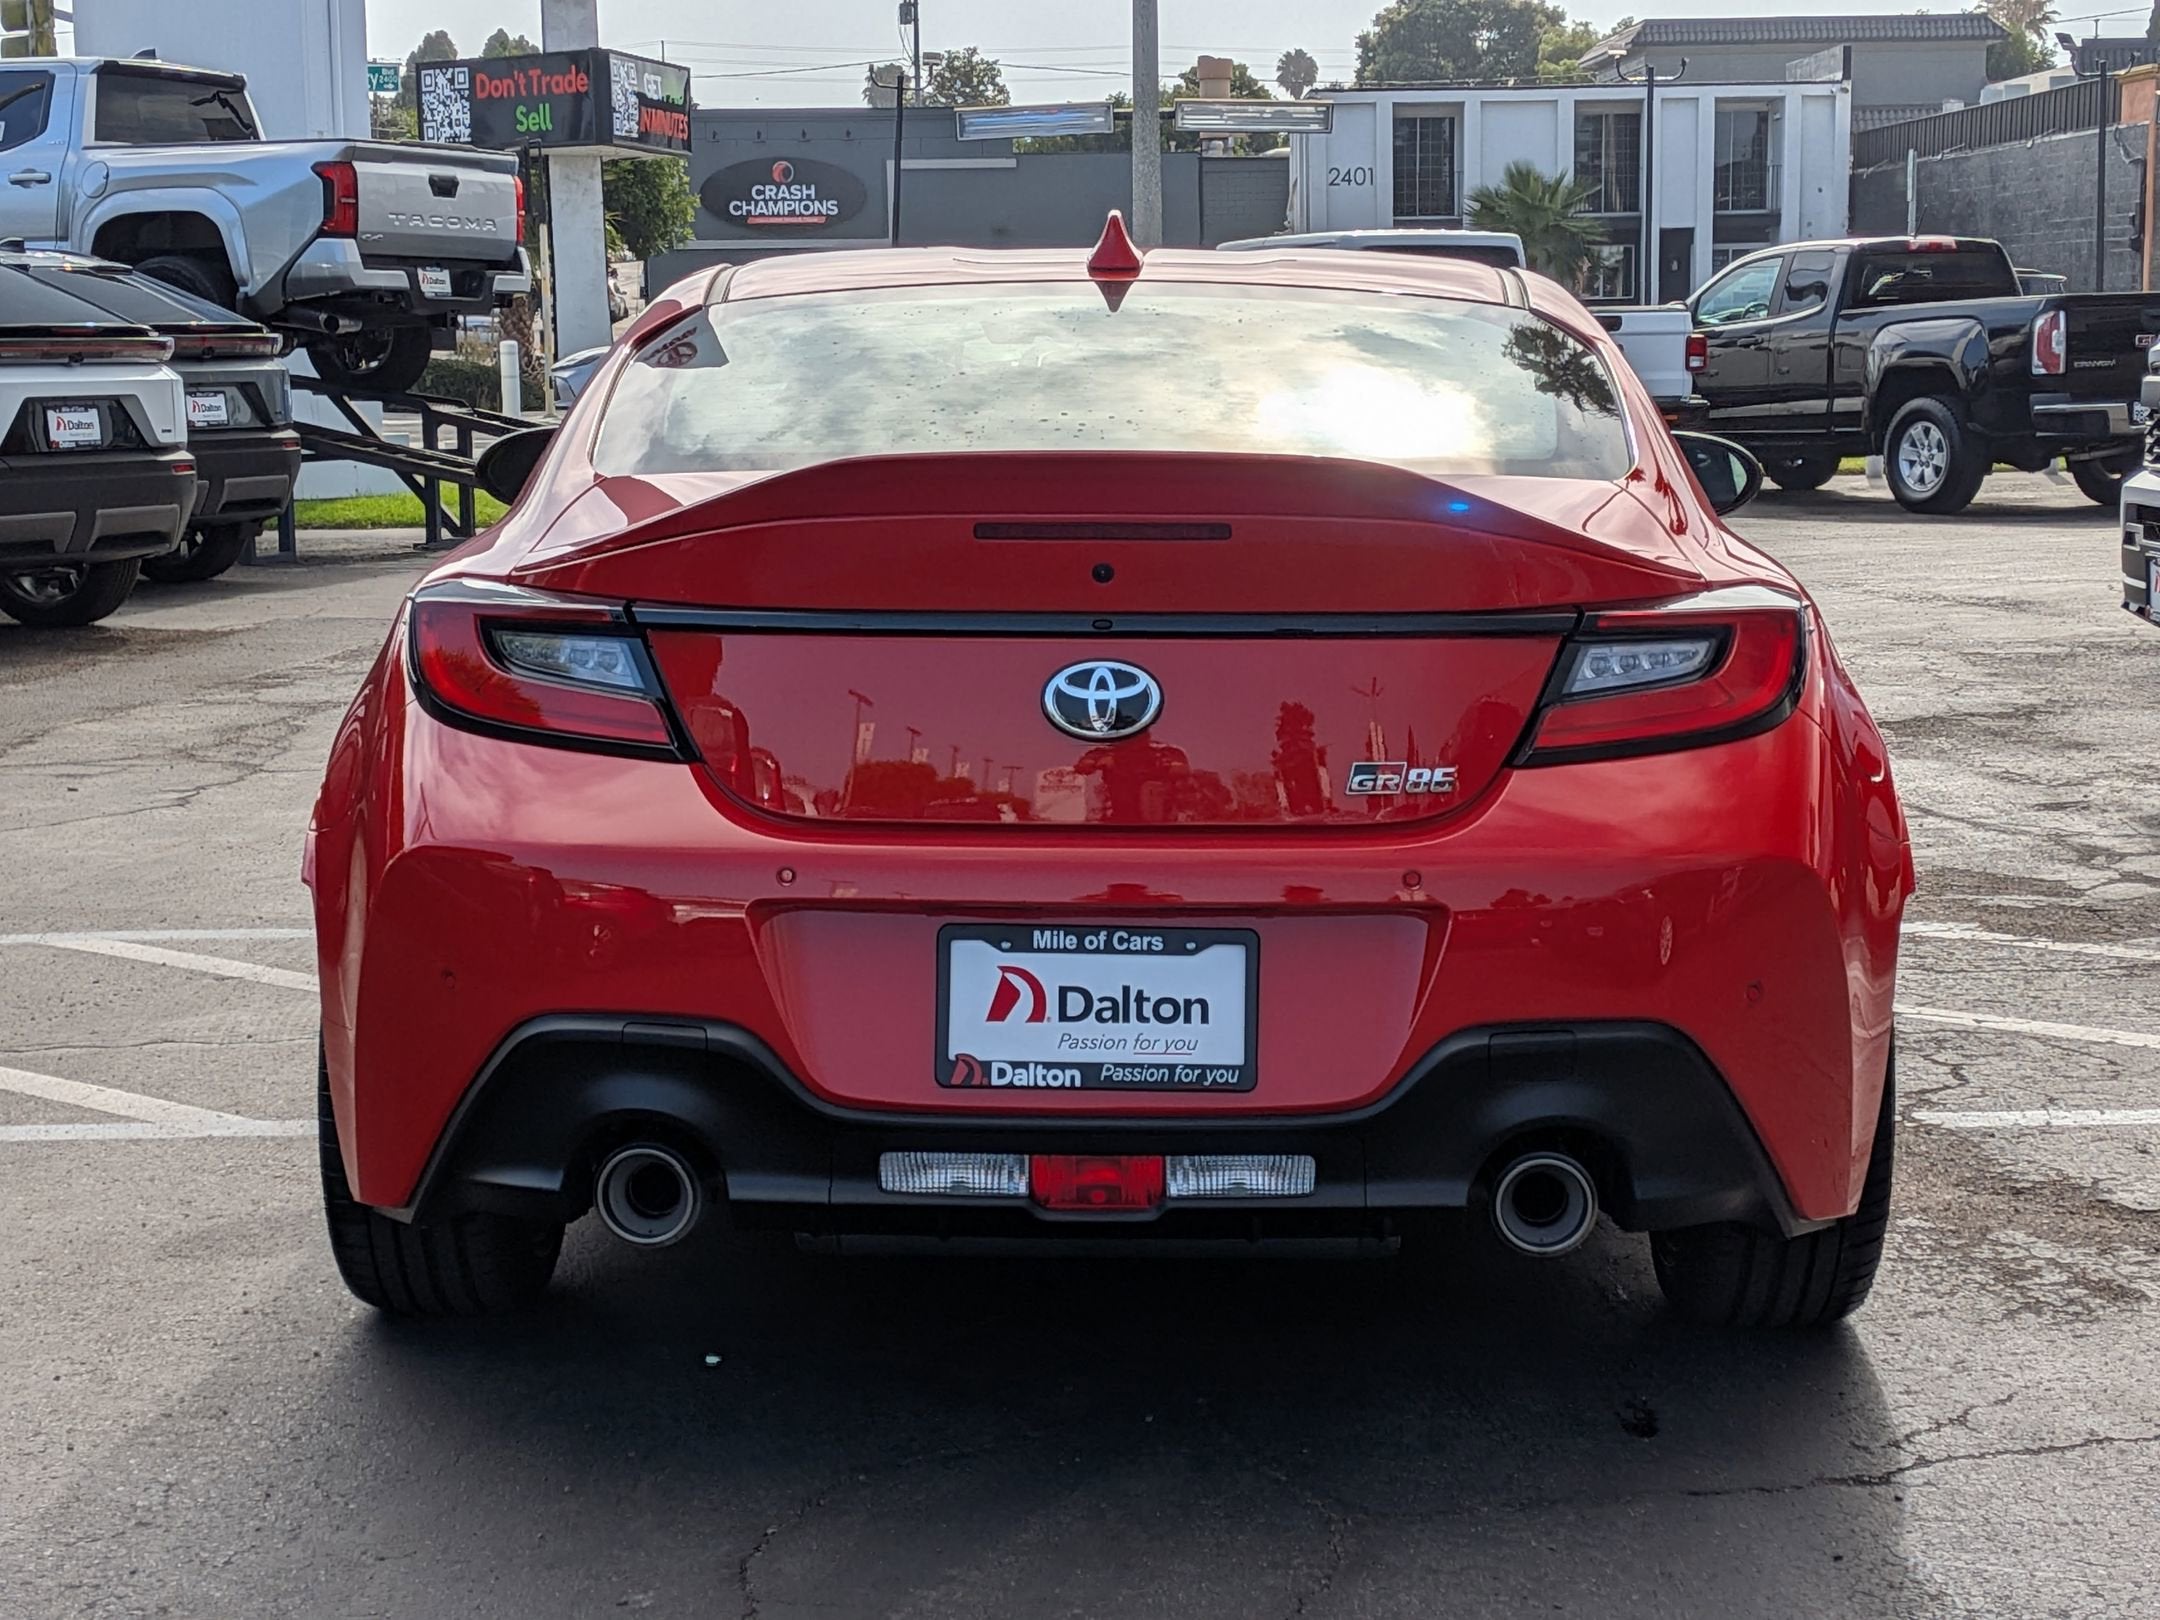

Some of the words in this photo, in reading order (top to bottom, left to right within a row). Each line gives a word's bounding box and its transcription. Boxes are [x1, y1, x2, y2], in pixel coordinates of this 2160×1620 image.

[475, 70, 526, 99] Don't
[528, 64, 588, 96] Trade
[515, 103, 553, 132] Sell
[1328, 166, 1374, 186] 2401
[751, 184, 815, 200] CRASH
[728, 200, 839, 216] CHAMPIONS
[388, 212, 497, 231] TACOMA
[67, 419, 95, 431] Dalton
[1033, 930, 1078, 950] Mile
[1084, 930, 1107, 950] of
[1112, 931, 1164, 951] Cars
[1058, 985, 1209, 1025] Dalton
[1057, 1033, 1127, 1050] Passion
[1133, 1033, 1160, 1051] for
[1163, 1039, 1199, 1053] you
[990, 1061, 1082, 1087] Dalton
[1100, 1064, 1169, 1083] Passion
[1174, 1065, 1201, 1083] for
[1203, 1068, 1239, 1086] you
